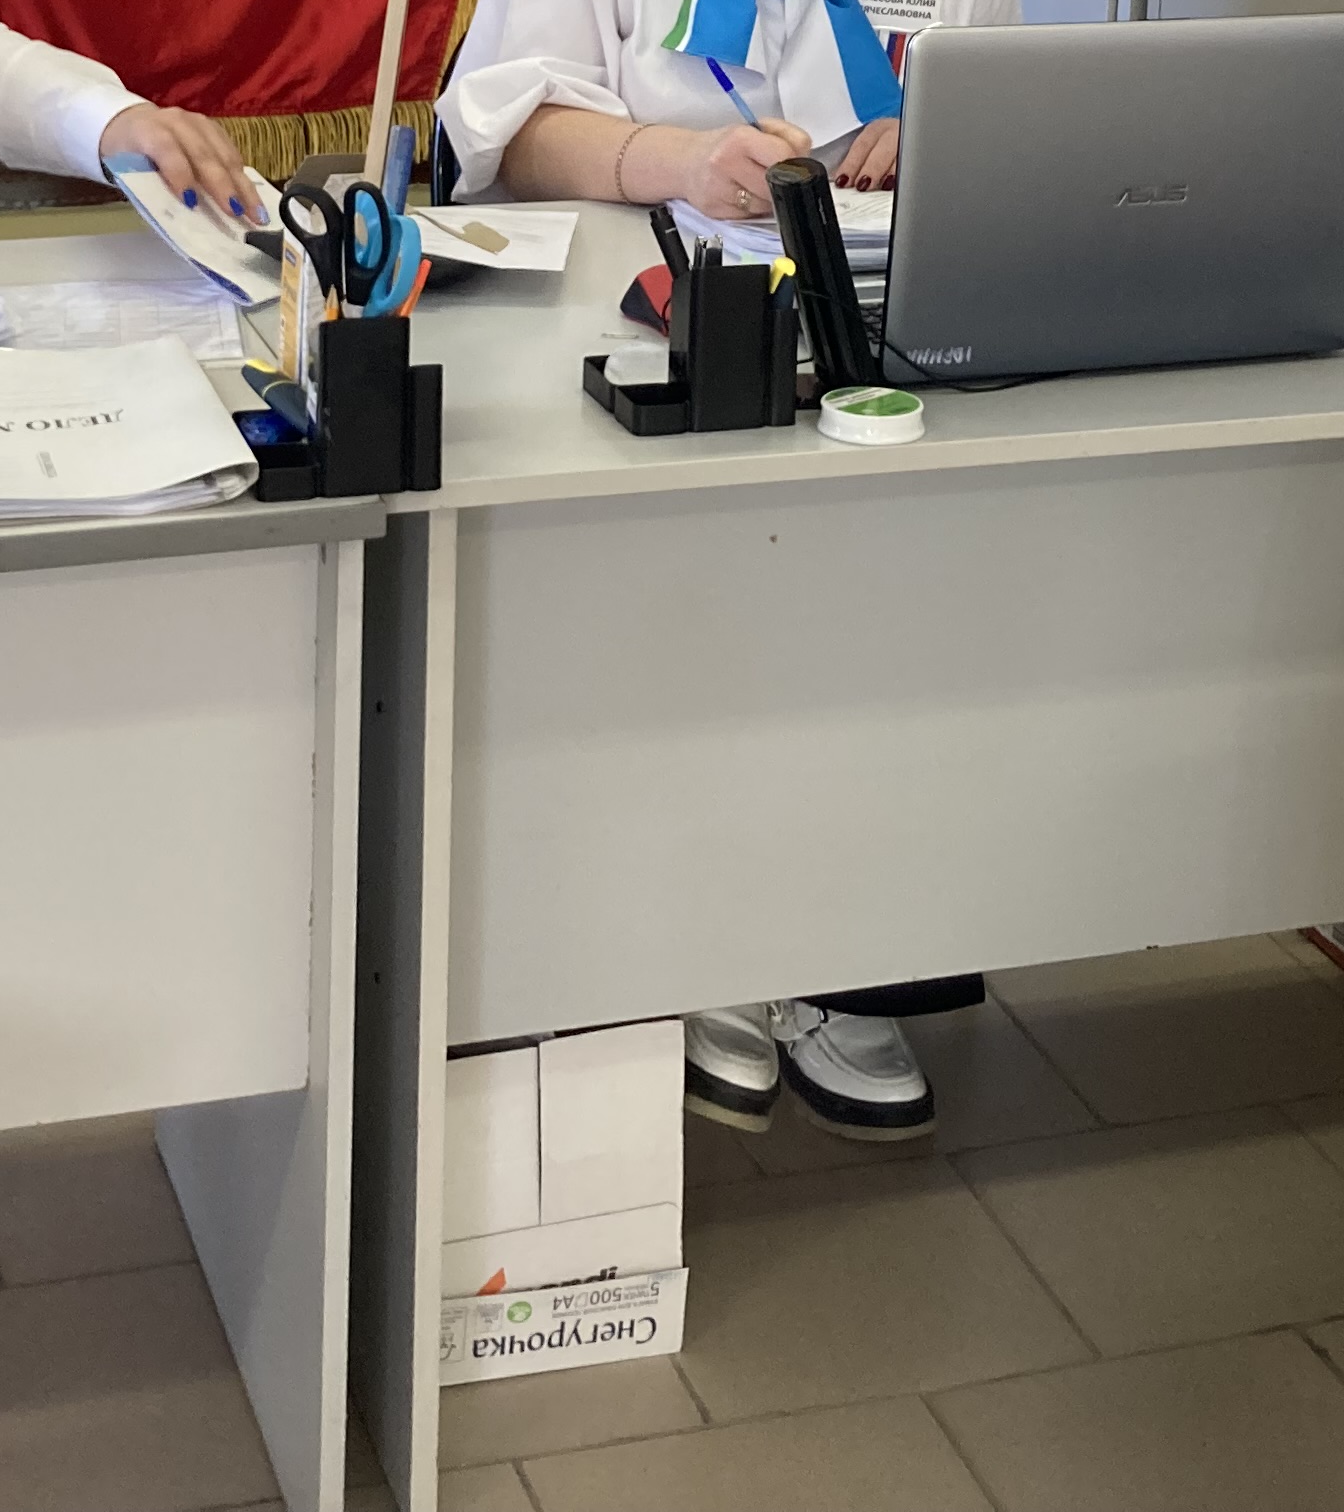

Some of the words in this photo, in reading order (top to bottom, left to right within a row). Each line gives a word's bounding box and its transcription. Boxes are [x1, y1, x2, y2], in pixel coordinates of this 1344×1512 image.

[863, 5, 932, 19] ЯЧЕСЛАВОВНА
[1116, 184, 1189, 207] ASUS
[589, 1288, 623, 1306] 500
[471, 1316, 658, 1359] Снегурочка
